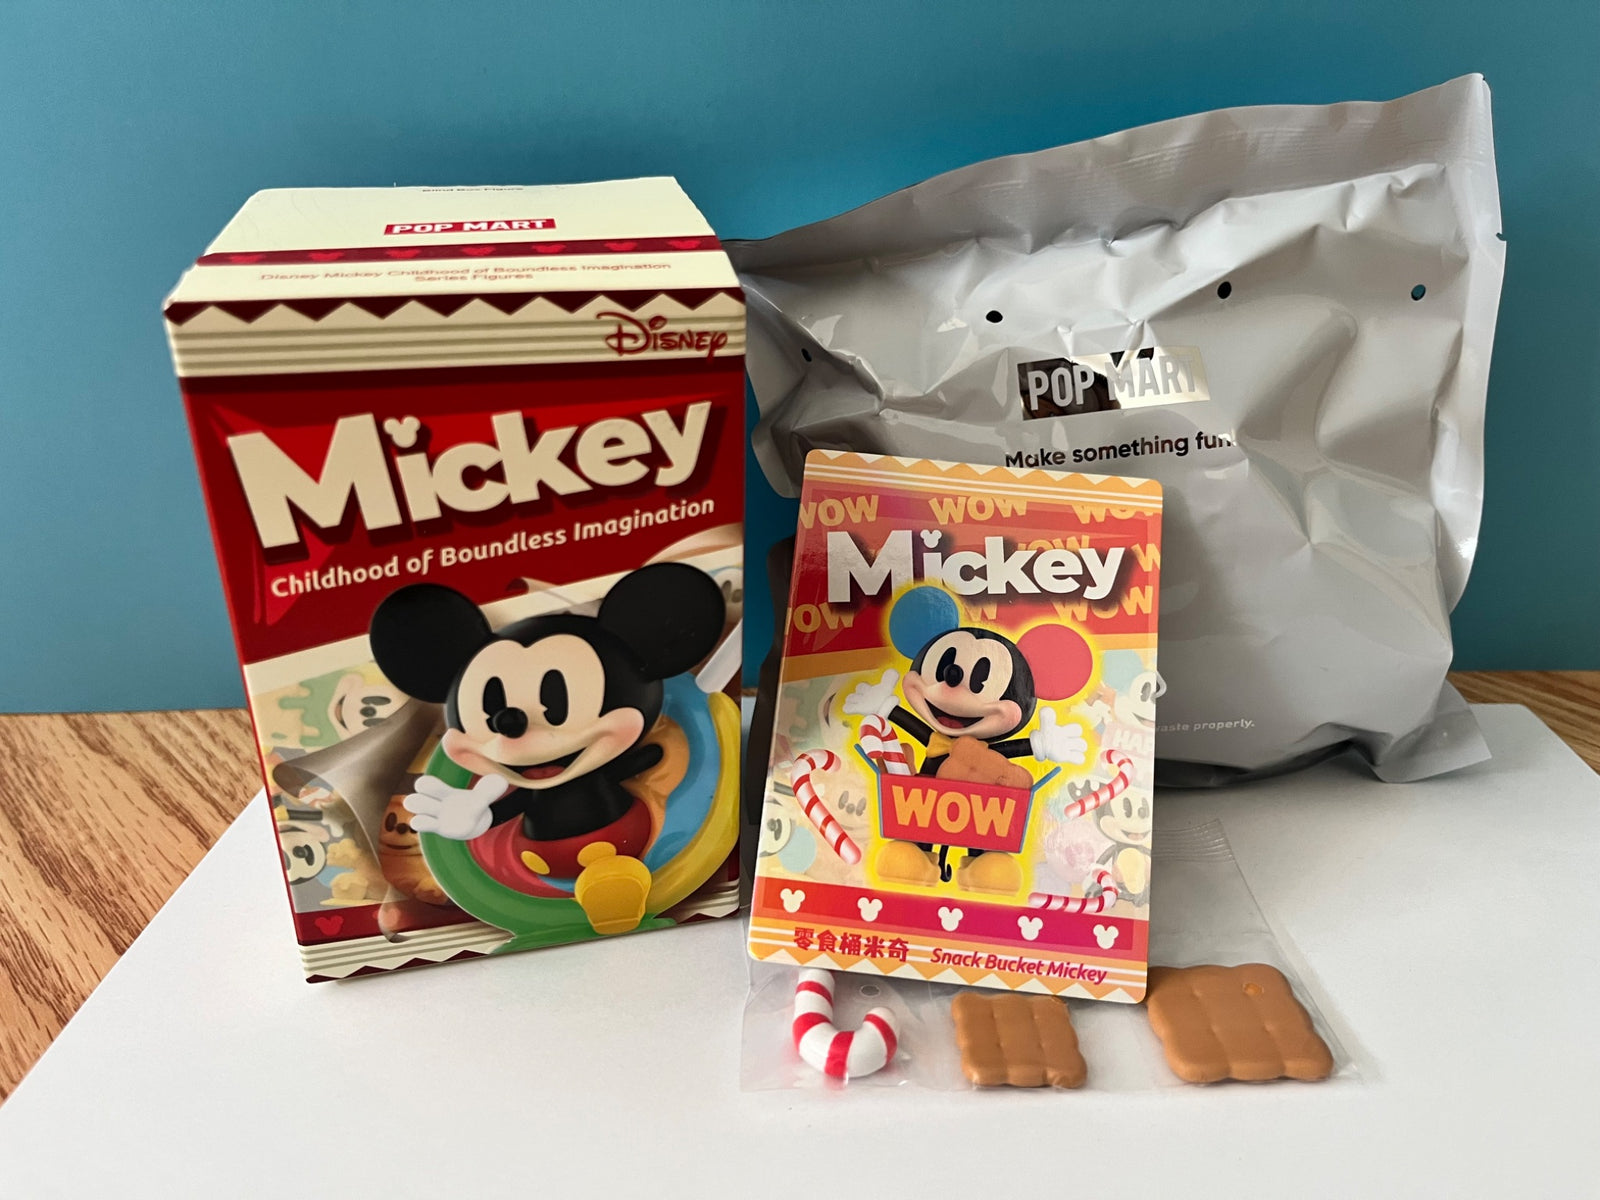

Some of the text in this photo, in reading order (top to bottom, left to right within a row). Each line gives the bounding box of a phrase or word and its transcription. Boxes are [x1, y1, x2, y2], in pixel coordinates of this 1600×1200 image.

[392, 219, 547, 235] POP MART
[260, 273, 320, 281] Disney
[324, 270, 383, 279] Mickey
[387, 268, 470, 276] Childhood
[493, 265, 577, 273] Boundless
[581, 263, 671, 271] Imagination
[472, 273, 534, 281] Figures
[1027, 355, 1197, 411] POP MART
[1005, 447, 1067, 469] Make
[1072, 435, 1189, 462] something
[226, 401, 713, 549] Mickey
[928, 495, 1028, 526] WOW
[271, 498, 715, 598] Childhood of Boundless Imagination
[827, 528, 1126, 603] Mickey
[1193, 718, 1256, 732] properly.
[890, 785, 1017, 838] WOW
[793, 926, 910, 963] 零食桶米奇
[930, 947, 1108, 986] Snack Bucket Mickey
